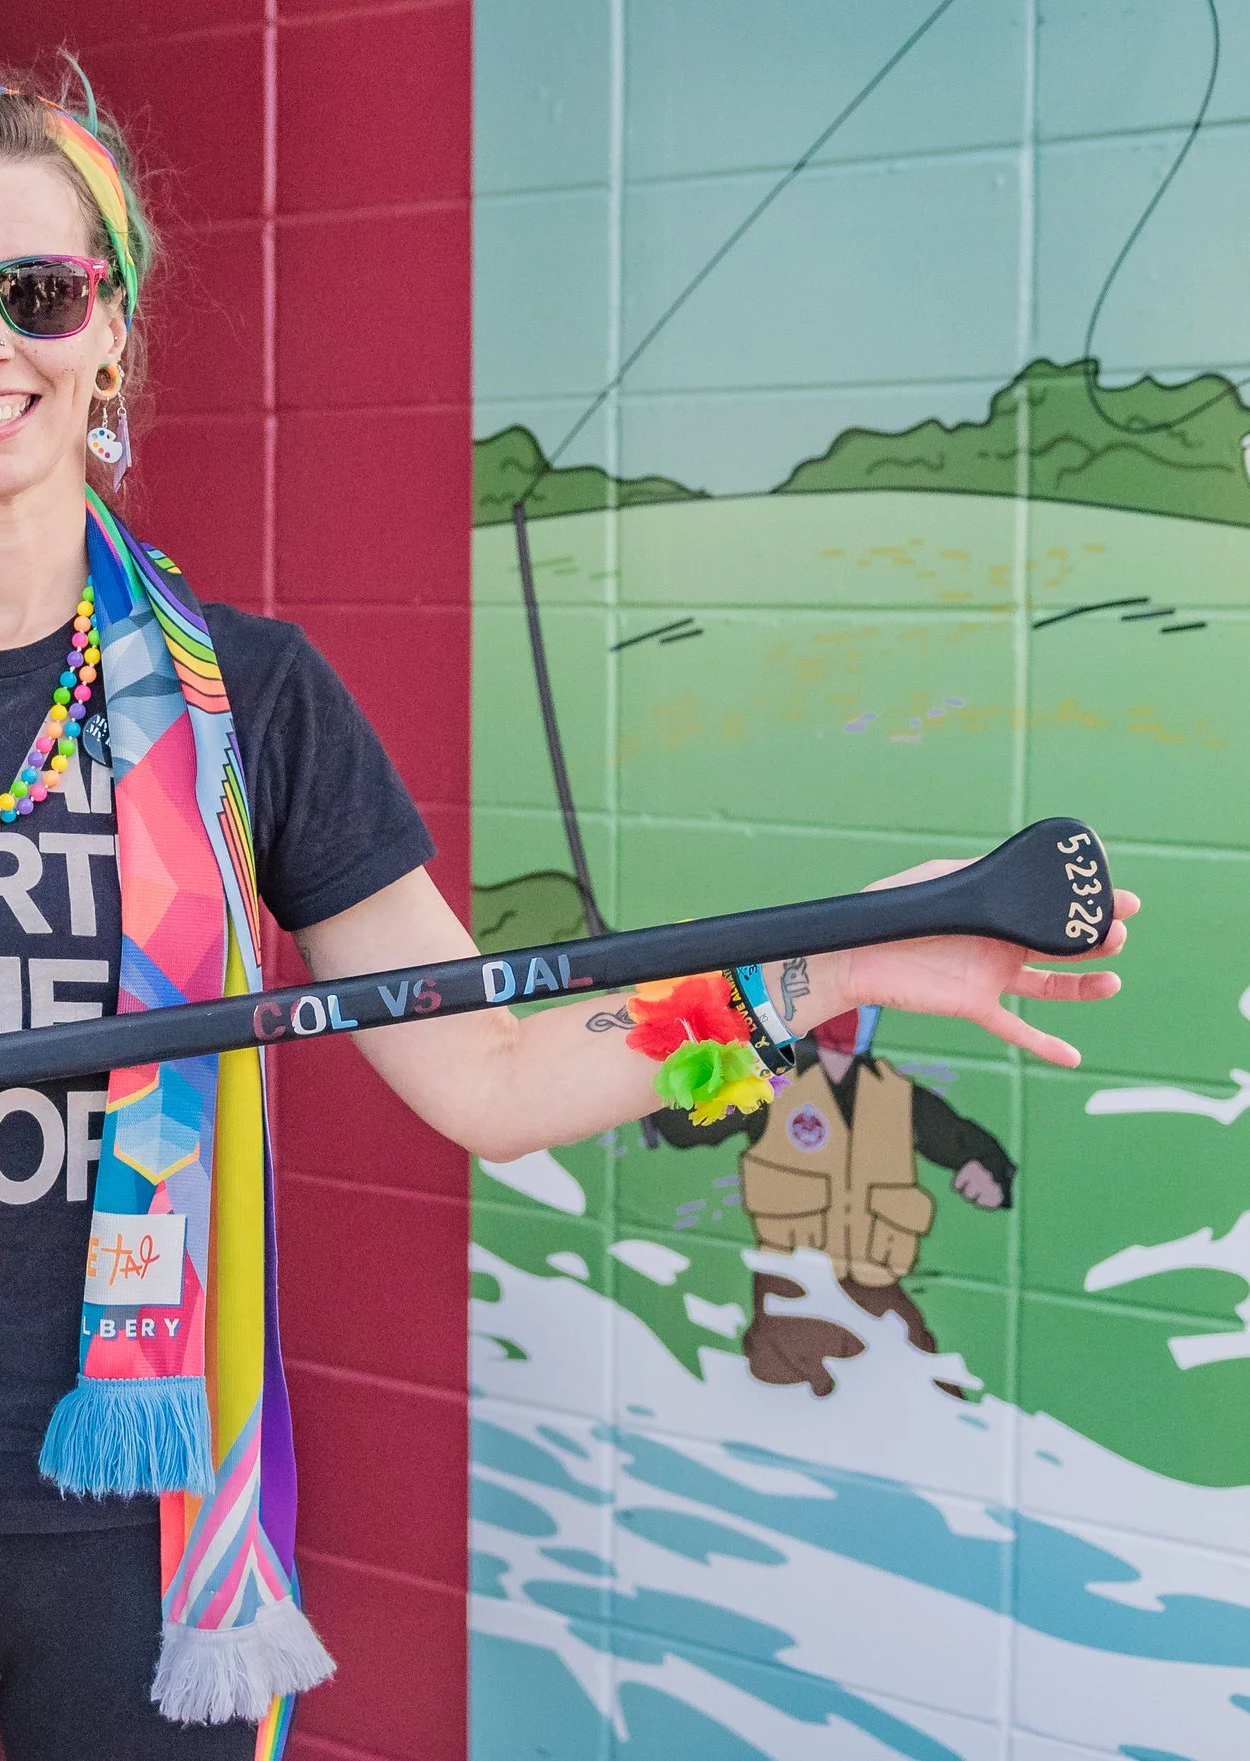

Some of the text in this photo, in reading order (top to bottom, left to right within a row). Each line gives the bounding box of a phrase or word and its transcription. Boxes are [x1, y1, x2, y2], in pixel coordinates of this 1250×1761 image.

[253, 953, 594, 1041] COL VS DAL
